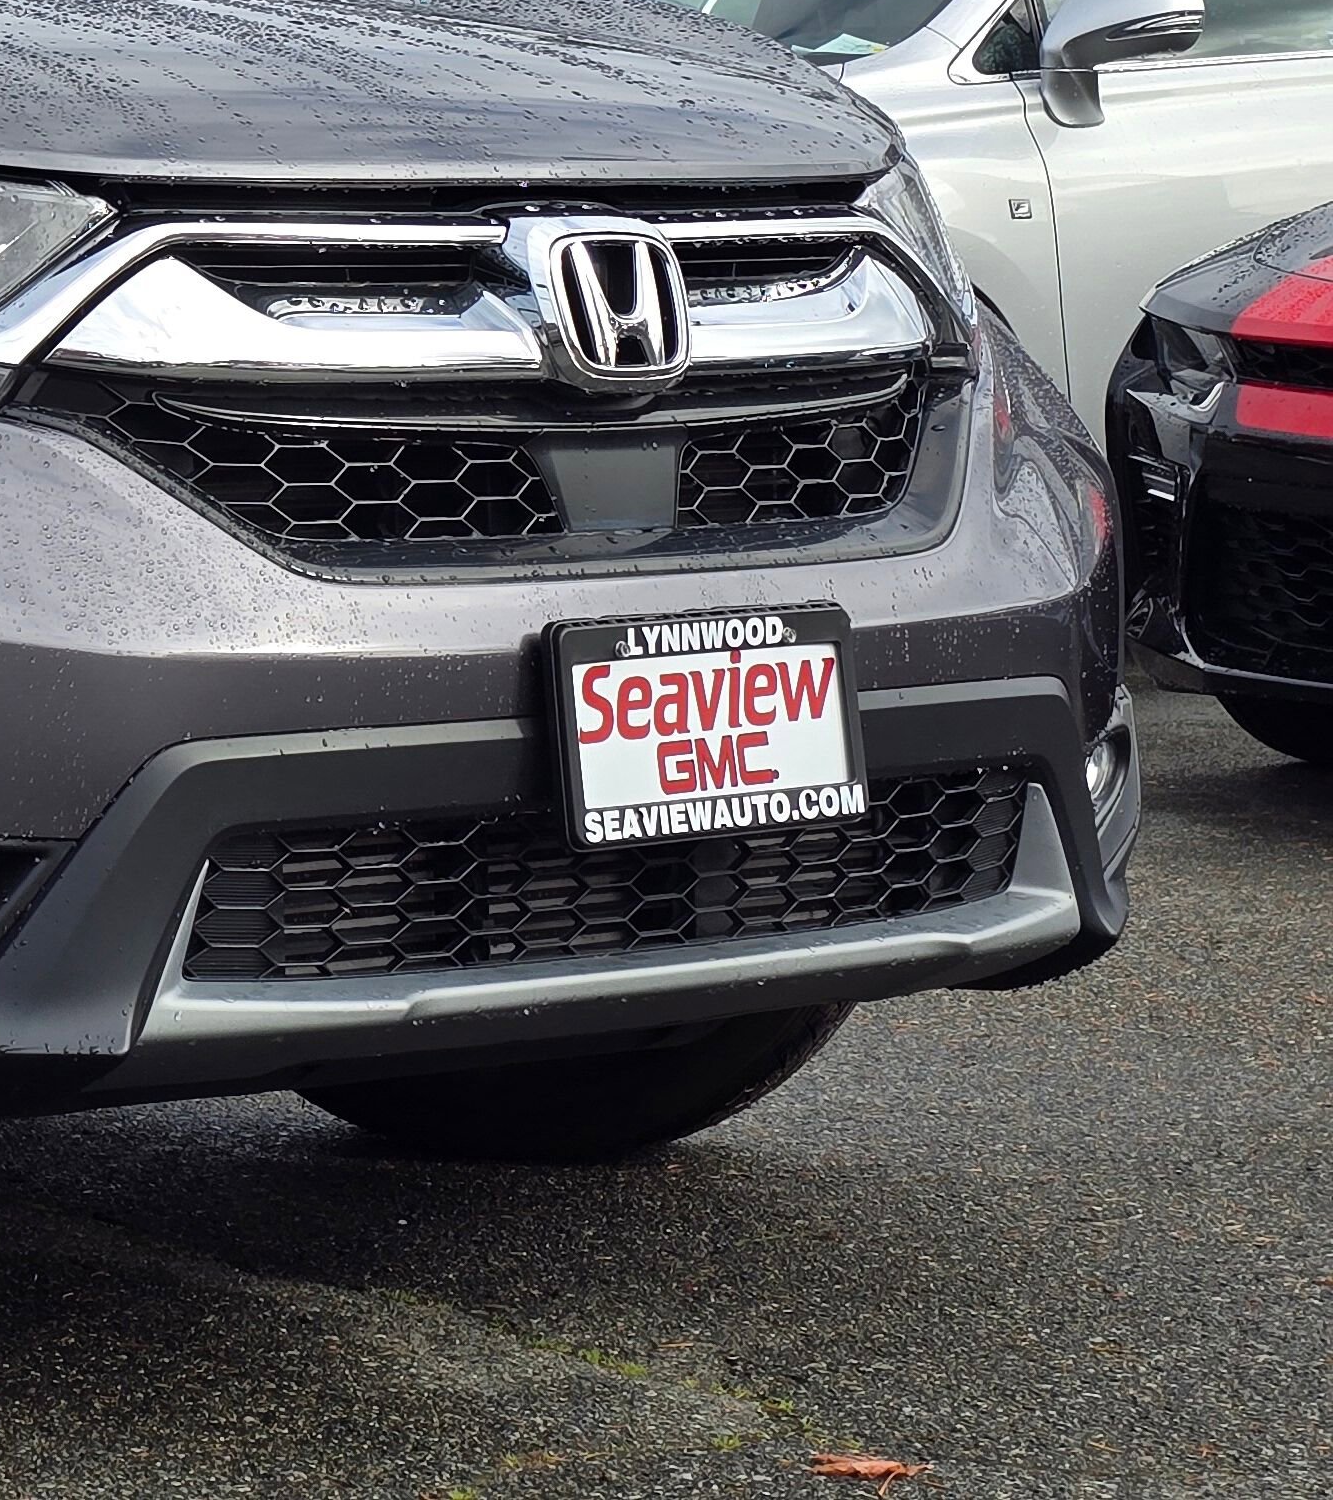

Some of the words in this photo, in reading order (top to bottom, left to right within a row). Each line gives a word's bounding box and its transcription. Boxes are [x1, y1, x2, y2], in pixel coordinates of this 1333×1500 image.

[627, 616, 784, 656] LYNNWOOD
[578, 647, 835, 745] Seaview
[657, 731, 779, 796] GMC
[584, 784, 865, 843] SEAVIEWAUTO.COM
